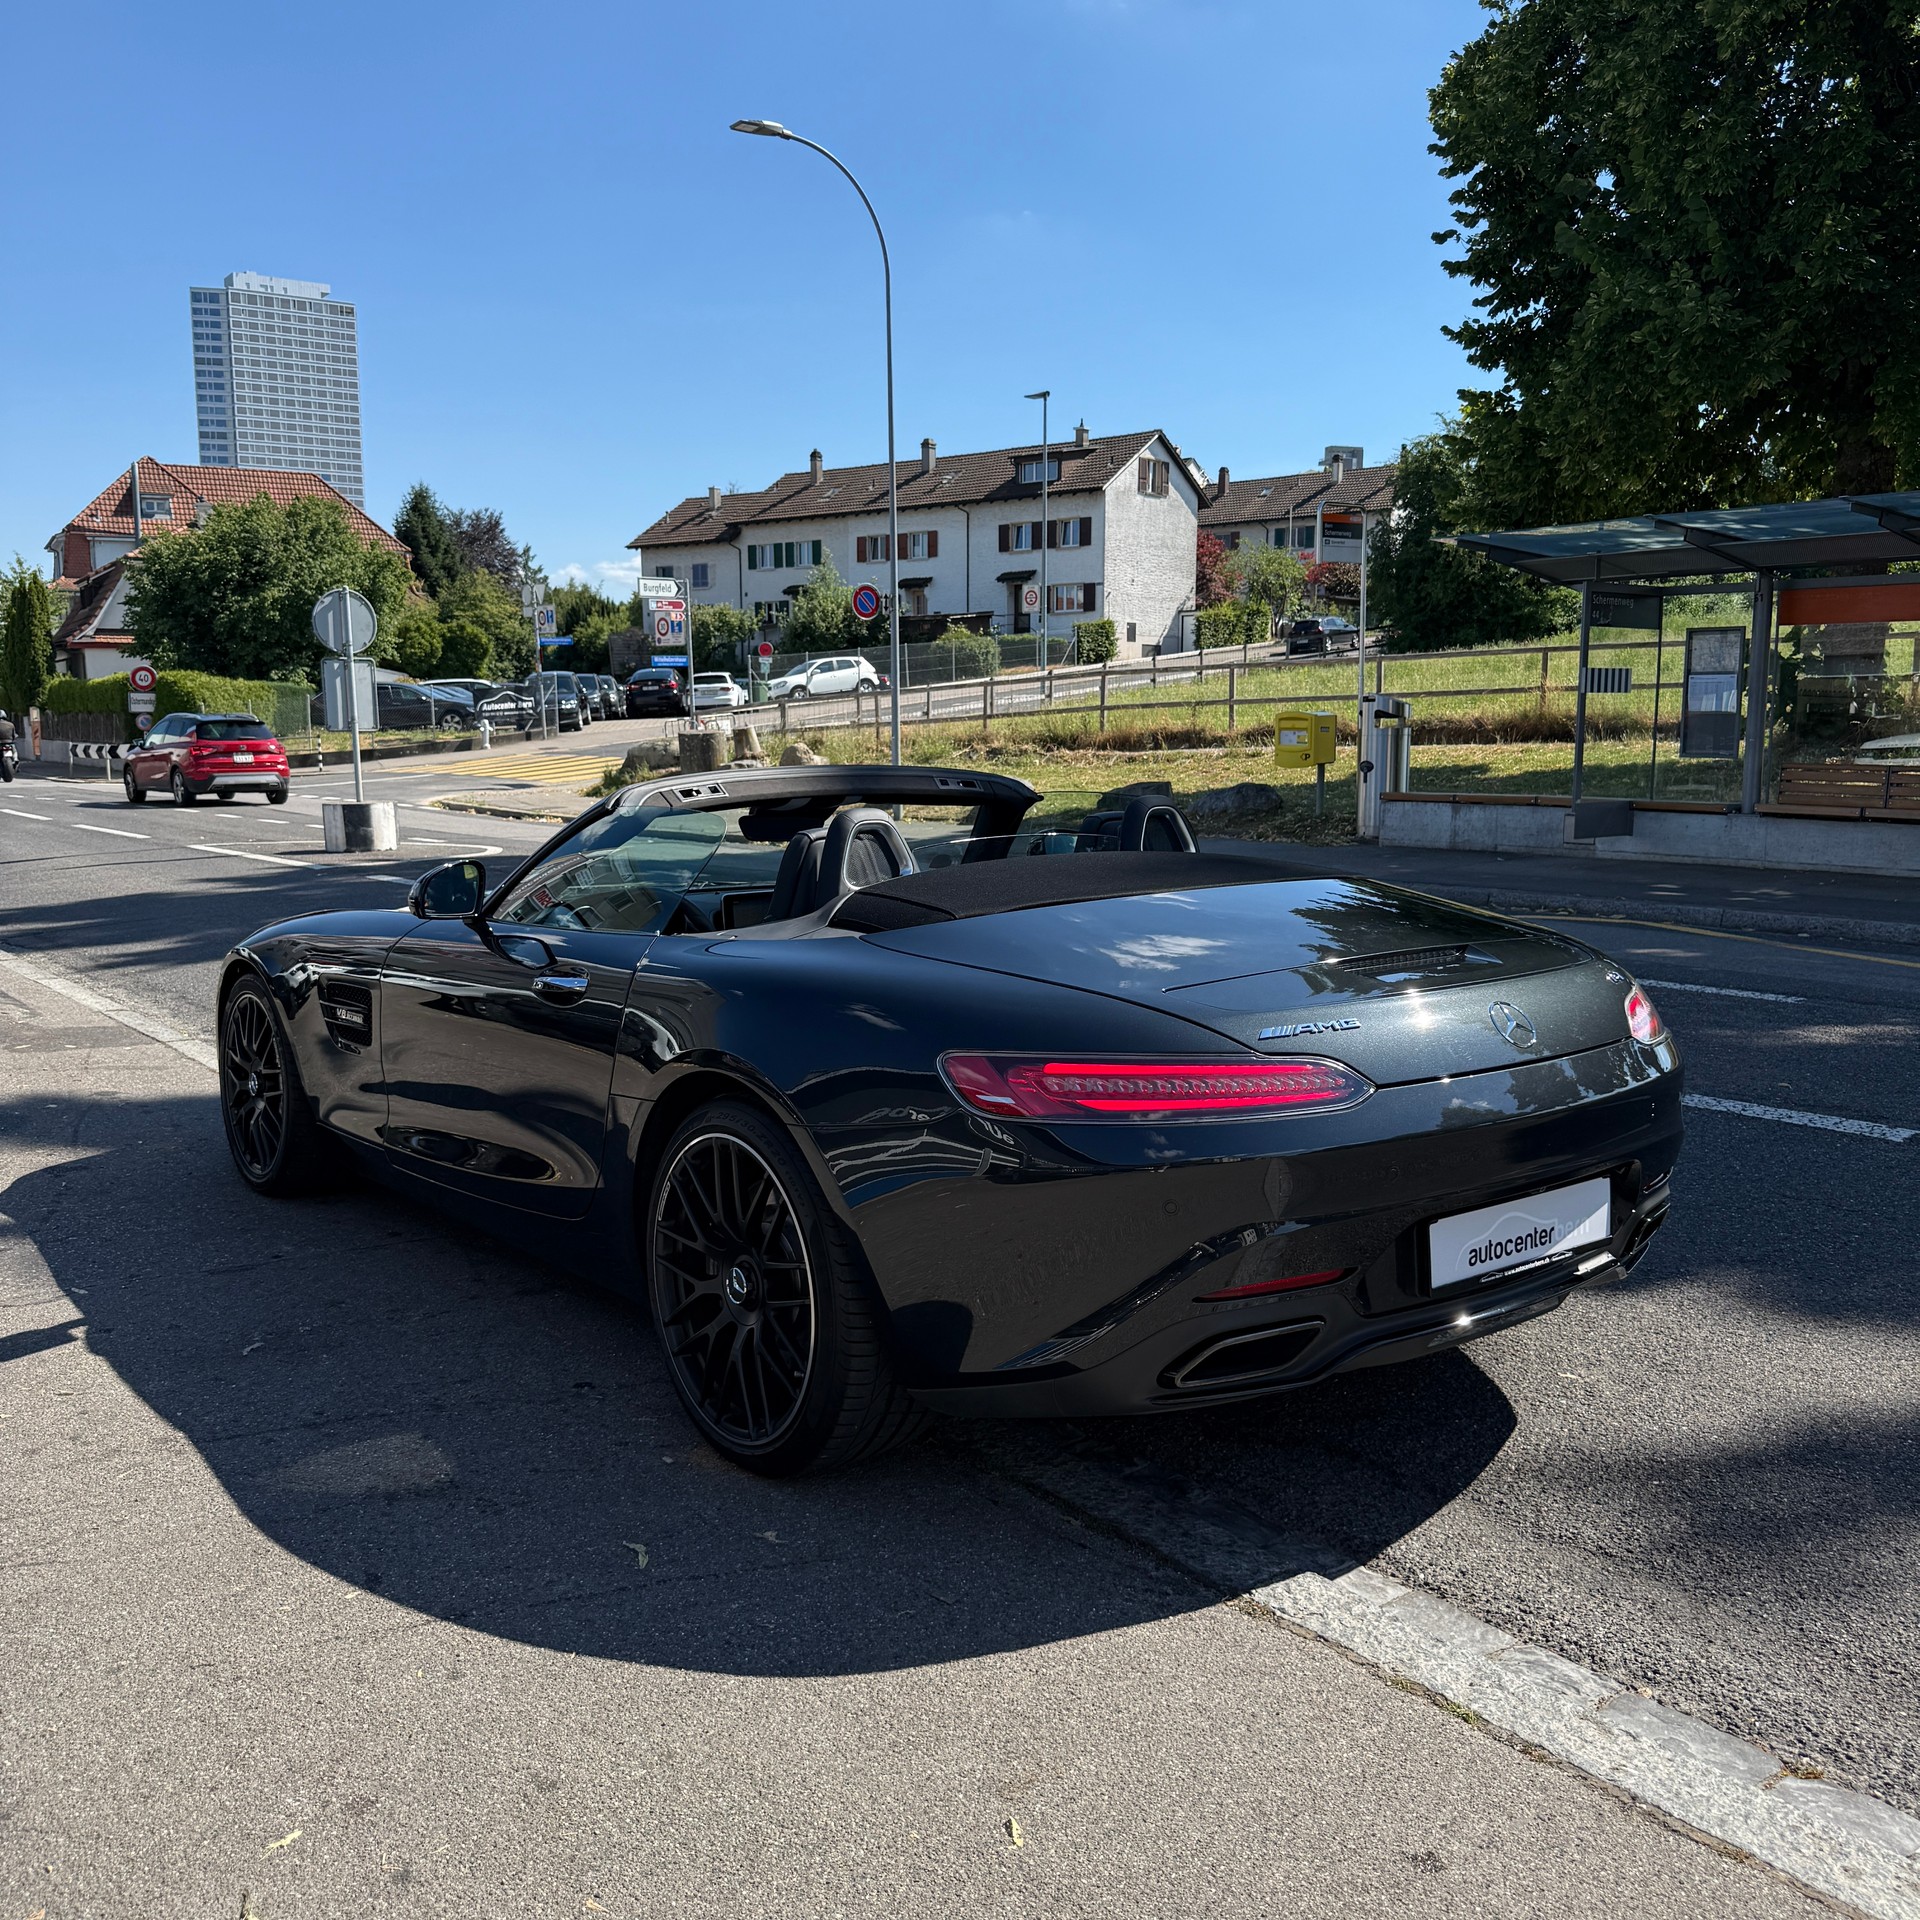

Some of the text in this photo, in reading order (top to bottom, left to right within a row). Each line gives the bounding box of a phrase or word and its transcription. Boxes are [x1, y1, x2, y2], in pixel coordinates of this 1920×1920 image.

[643, 583, 672, 594] Burgfeld
[1592, 594, 1634, 608] Schermenweg
[138, 674, 149, 682] 40
[482, 700, 532, 711] Autocenter Bern
[1292, 1018, 1361, 1037] AMG
[1468, 1226, 1555, 1267] autocenter
